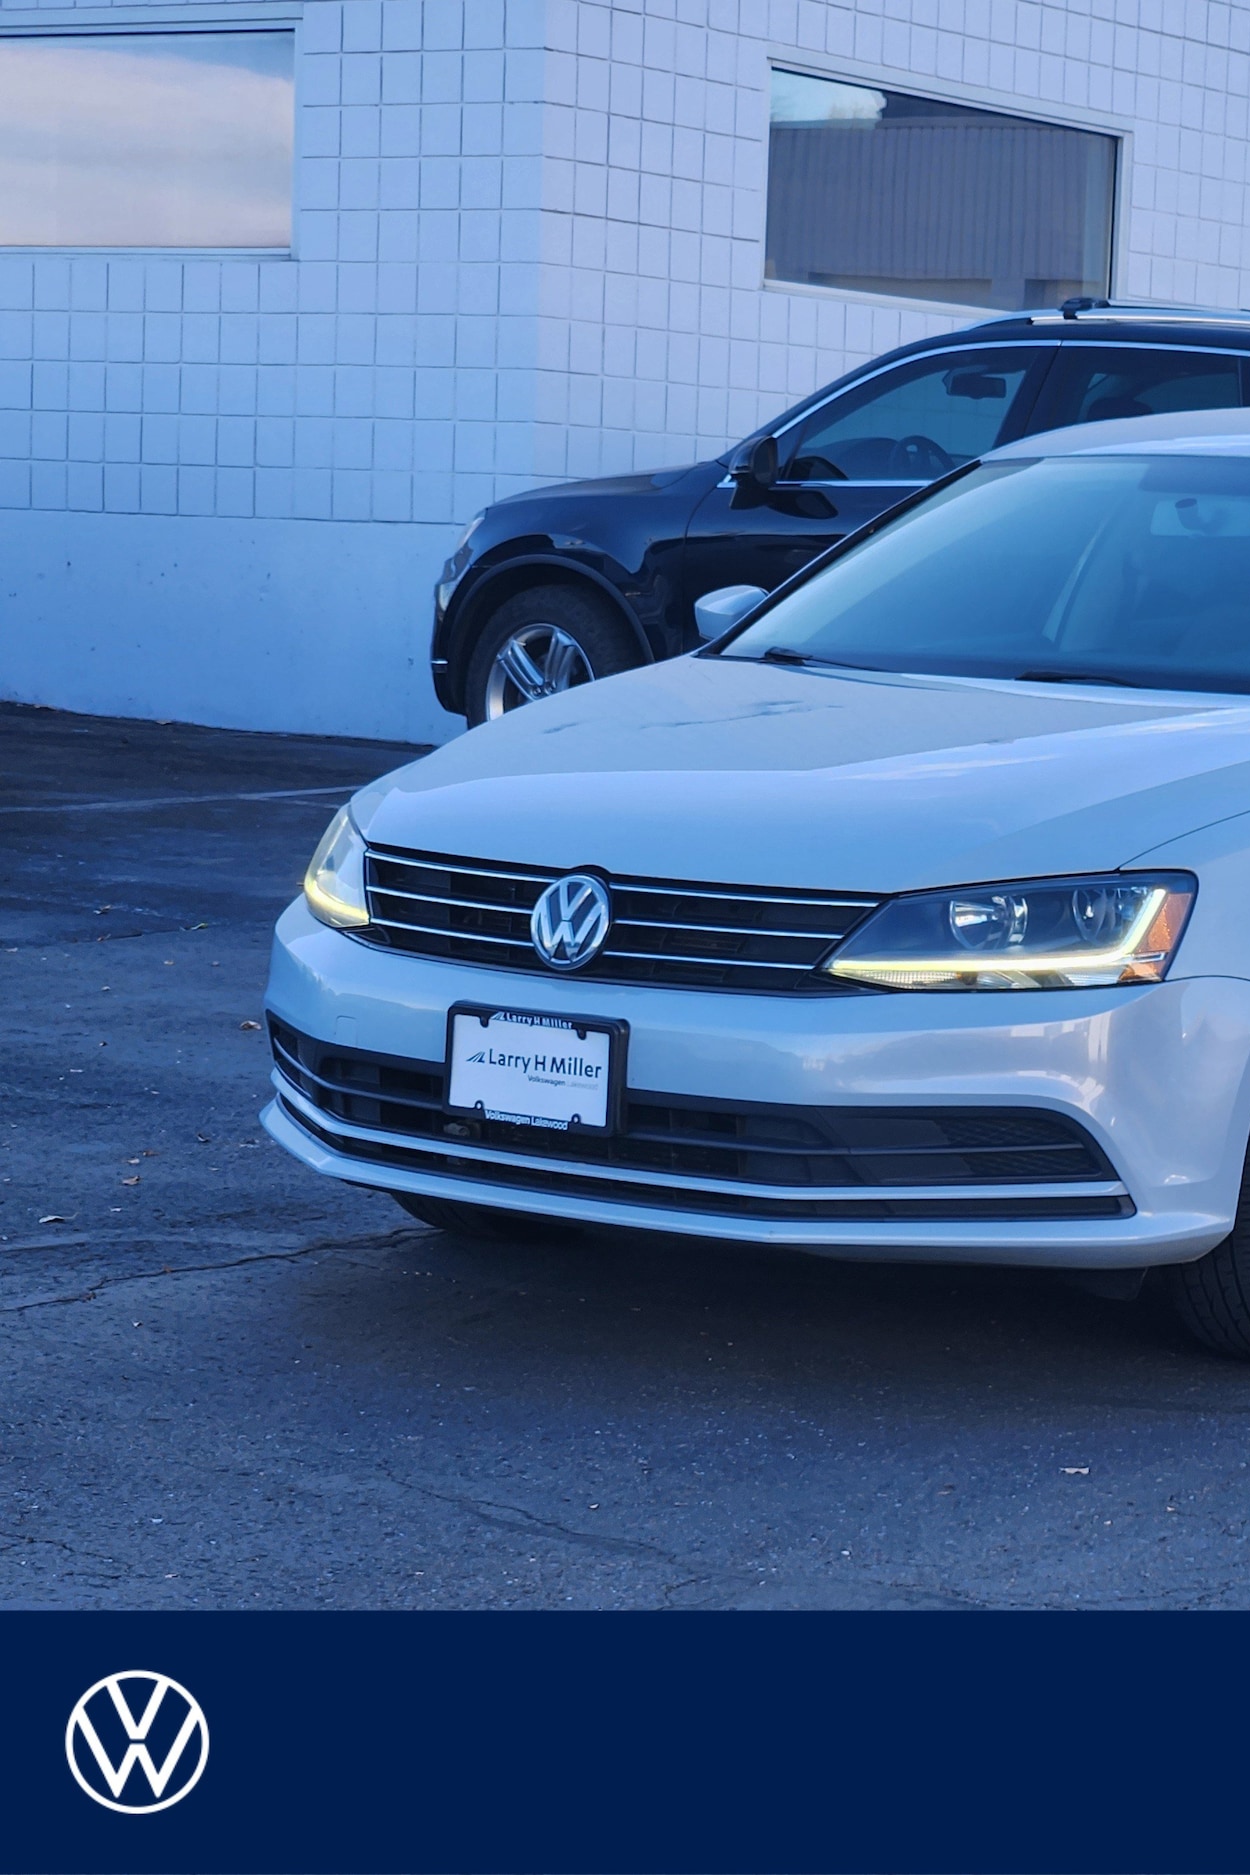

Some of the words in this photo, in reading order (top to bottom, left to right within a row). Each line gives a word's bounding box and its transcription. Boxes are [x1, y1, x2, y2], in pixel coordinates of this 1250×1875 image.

[506, 1012, 533, 1026] Larry
[533, 1016, 541, 1025] H
[542, 1018, 573, 1029] Miller
[489, 1048, 531, 1074] Larry
[534, 1054, 546, 1072] H
[550, 1056, 602, 1079] Miller
[527, 1074, 566, 1087] Volkswagen
[485, 1109, 531, 1125] Volkswagen
[531, 1116, 569, 1131] Lakewood
